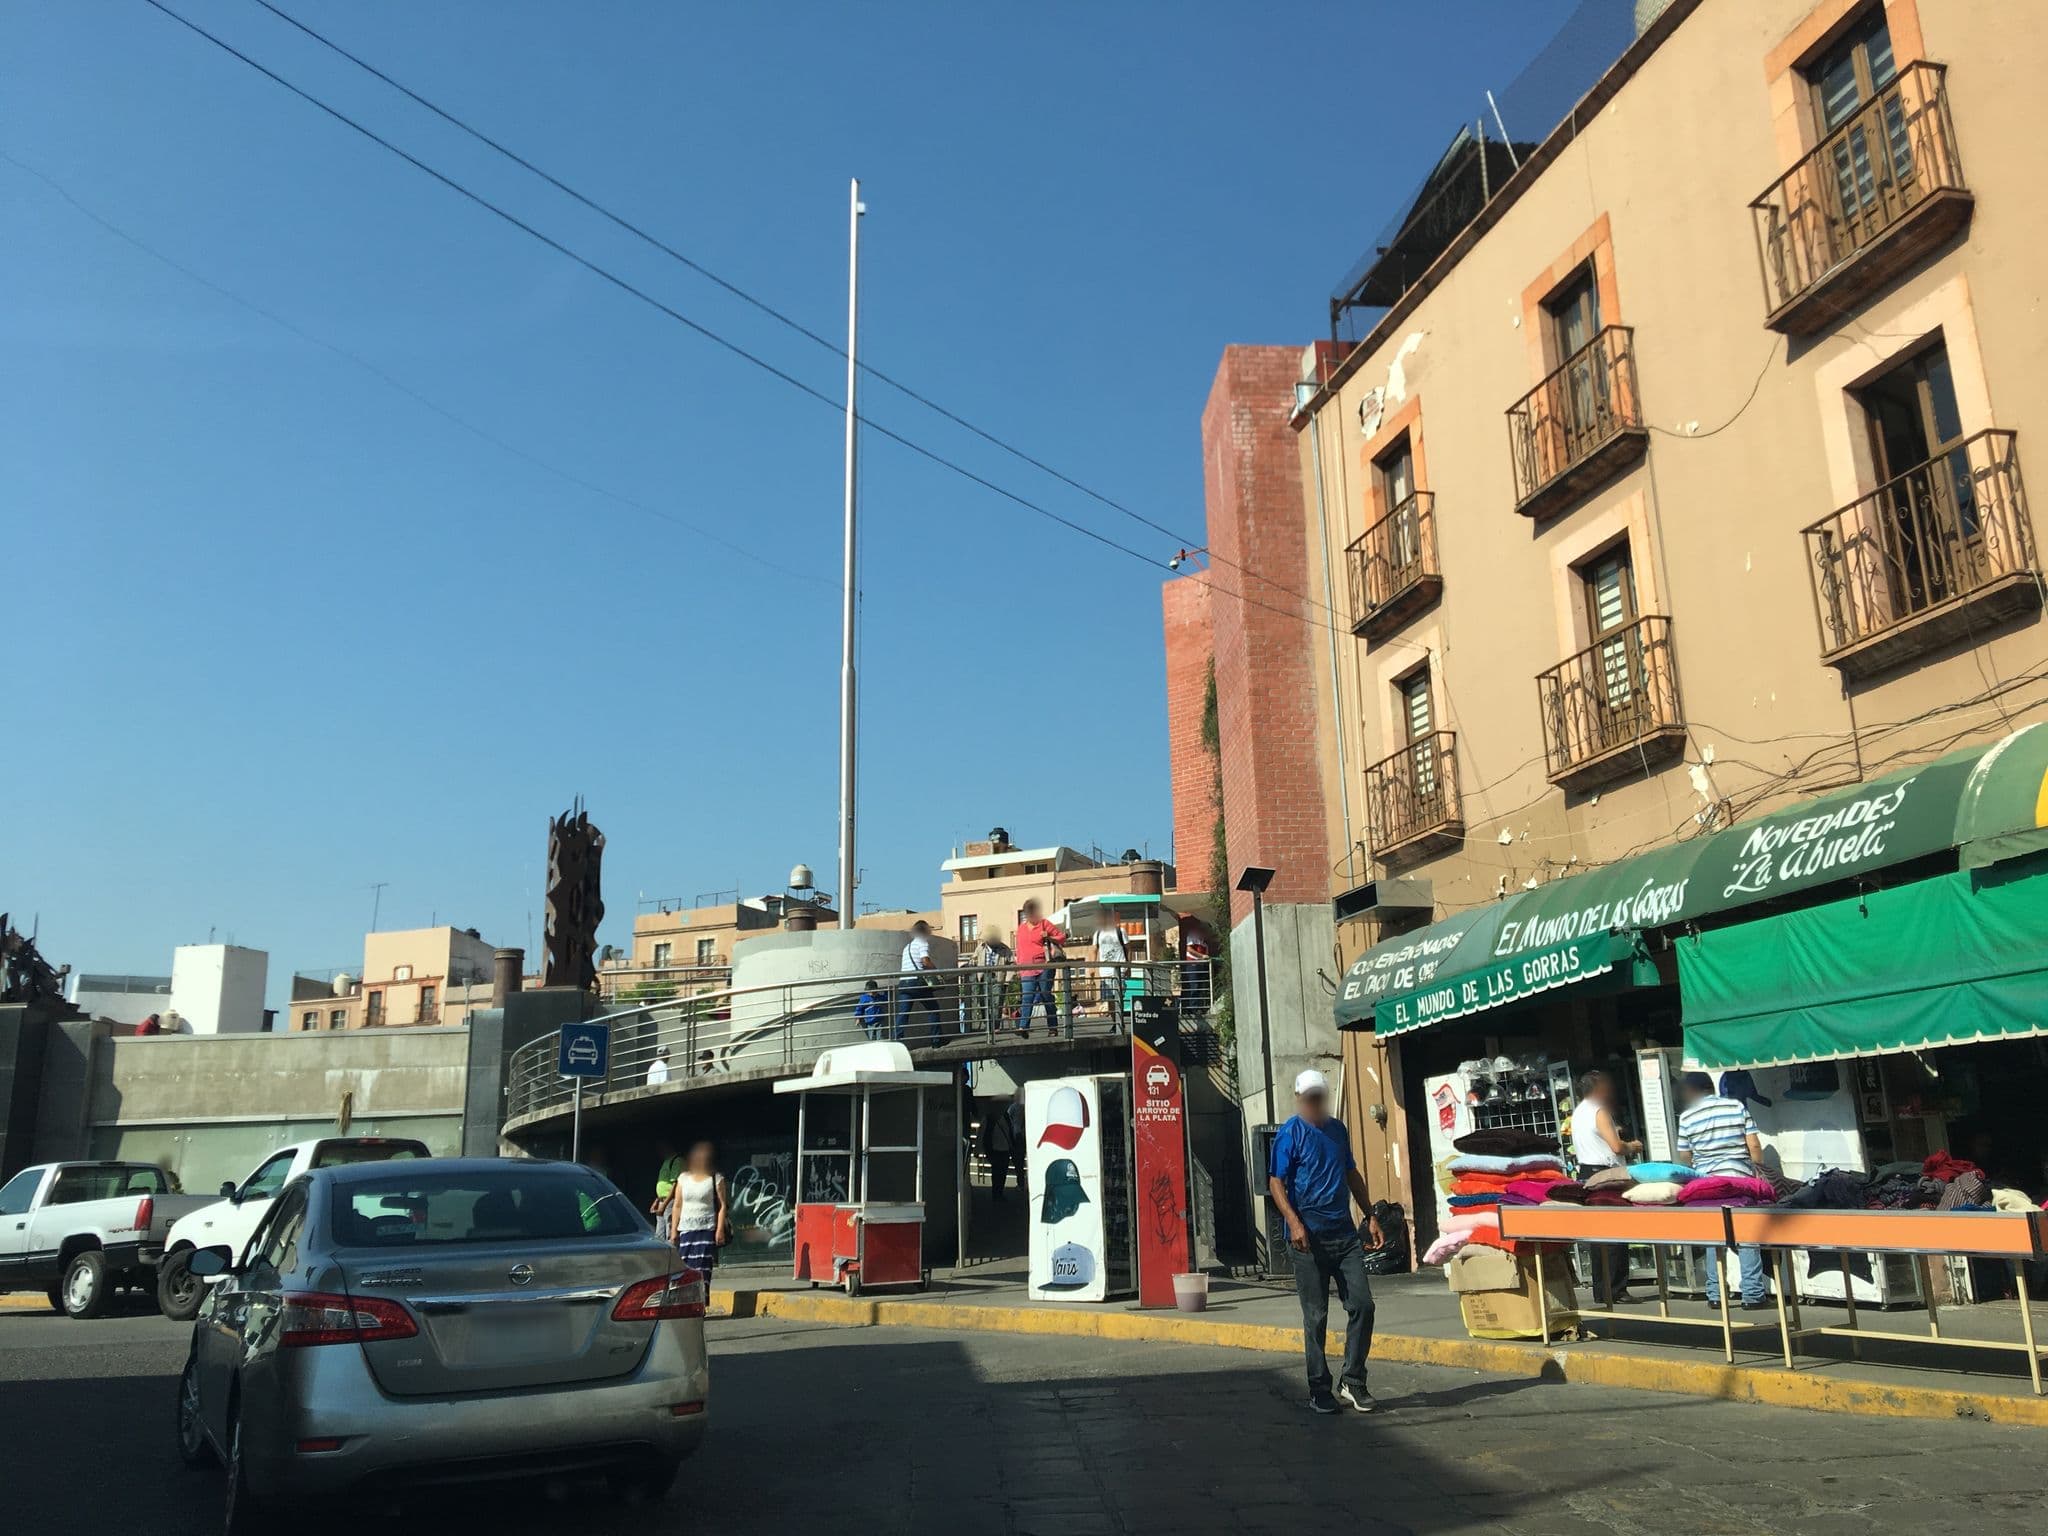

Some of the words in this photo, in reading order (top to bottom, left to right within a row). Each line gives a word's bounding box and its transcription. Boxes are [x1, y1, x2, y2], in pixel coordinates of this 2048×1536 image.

[1740, 777, 1916, 858] NOVEDADES
[1516, 912, 1580, 953] MUNDO
[1577, 903, 1606, 937] DE
[1600, 896, 1633, 930] LAS
[1631, 877, 1690, 925] GORRAS
[1343, 981, 1361, 1001] EL
[1393, 966, 1415, 988] DE
[1395, 1003, 1410, 1024] EL
[1417, 988, 1455, 1018] MUNDO
[1462, 980, 1480, 1004] DE
[1487, 969, 1514, 997] LAS
[1522, 946, 1580, 985] GORRAS
[1147, 1086, 1160, 1096] 131
[1136, 1107, 1169, 1115] ARROYO
[1169, 1107, 1181, 1115] DE
[1145, 1099, 1170, 1107] SITIO
[1139, 1114, 1151, 1122] LA
[1152, 1114, 1177, 1122] PLATA
